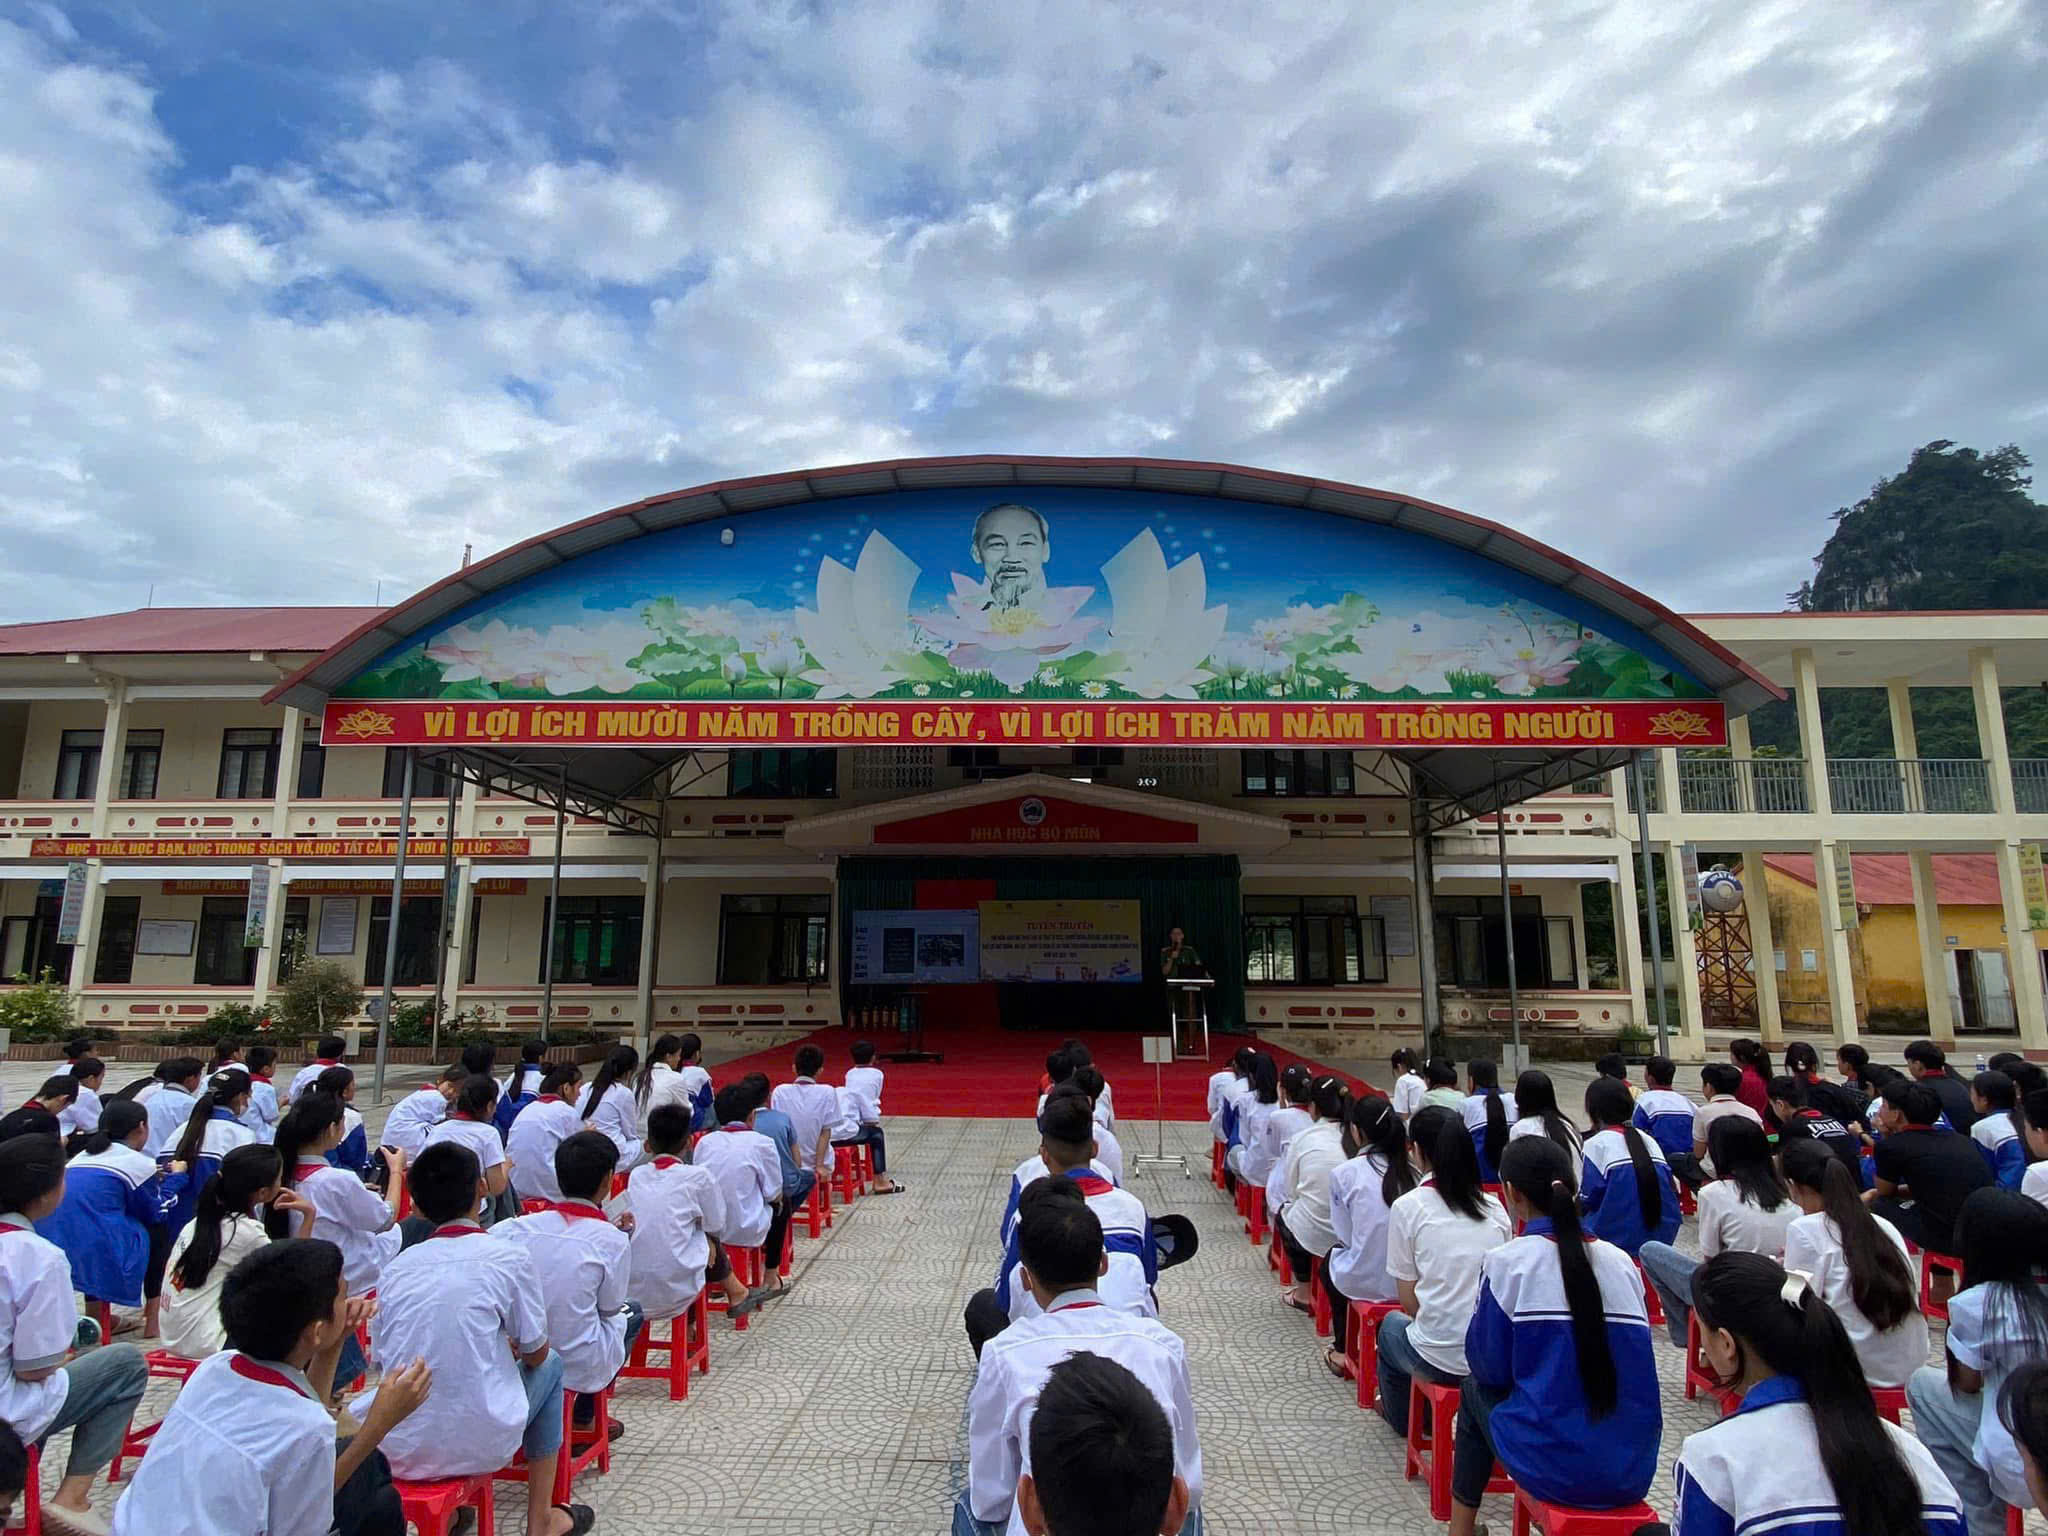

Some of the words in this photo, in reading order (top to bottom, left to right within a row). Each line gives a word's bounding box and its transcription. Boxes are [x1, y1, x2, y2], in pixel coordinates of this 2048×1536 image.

[423, 706, 455, 737] VÌ
[467, 709, 518, 741] LỢI
[531, 706, 585, 737] ÍCH
[598, 704, 686, 737] MƯỜI
[698, 706, 777, 737] NĂM
[791, 704, 900, 737] TRỒNG
[911, 708, 985, 740] CÂY,
[999, 706, 1030, 737] VÌ
[1042, 709, 1093, 742] LỢI
[1105, 706, 1158, 737] ÍCH
[1170, 706, 1269, 738] TRĂM
[1282, 706, 1364, 738] NĂM
[1376, 705, 1491, 739] TRỒNG
[1504, 705, 1614, 739] NGƯỜI
[386, 842, 411, 854] MI
